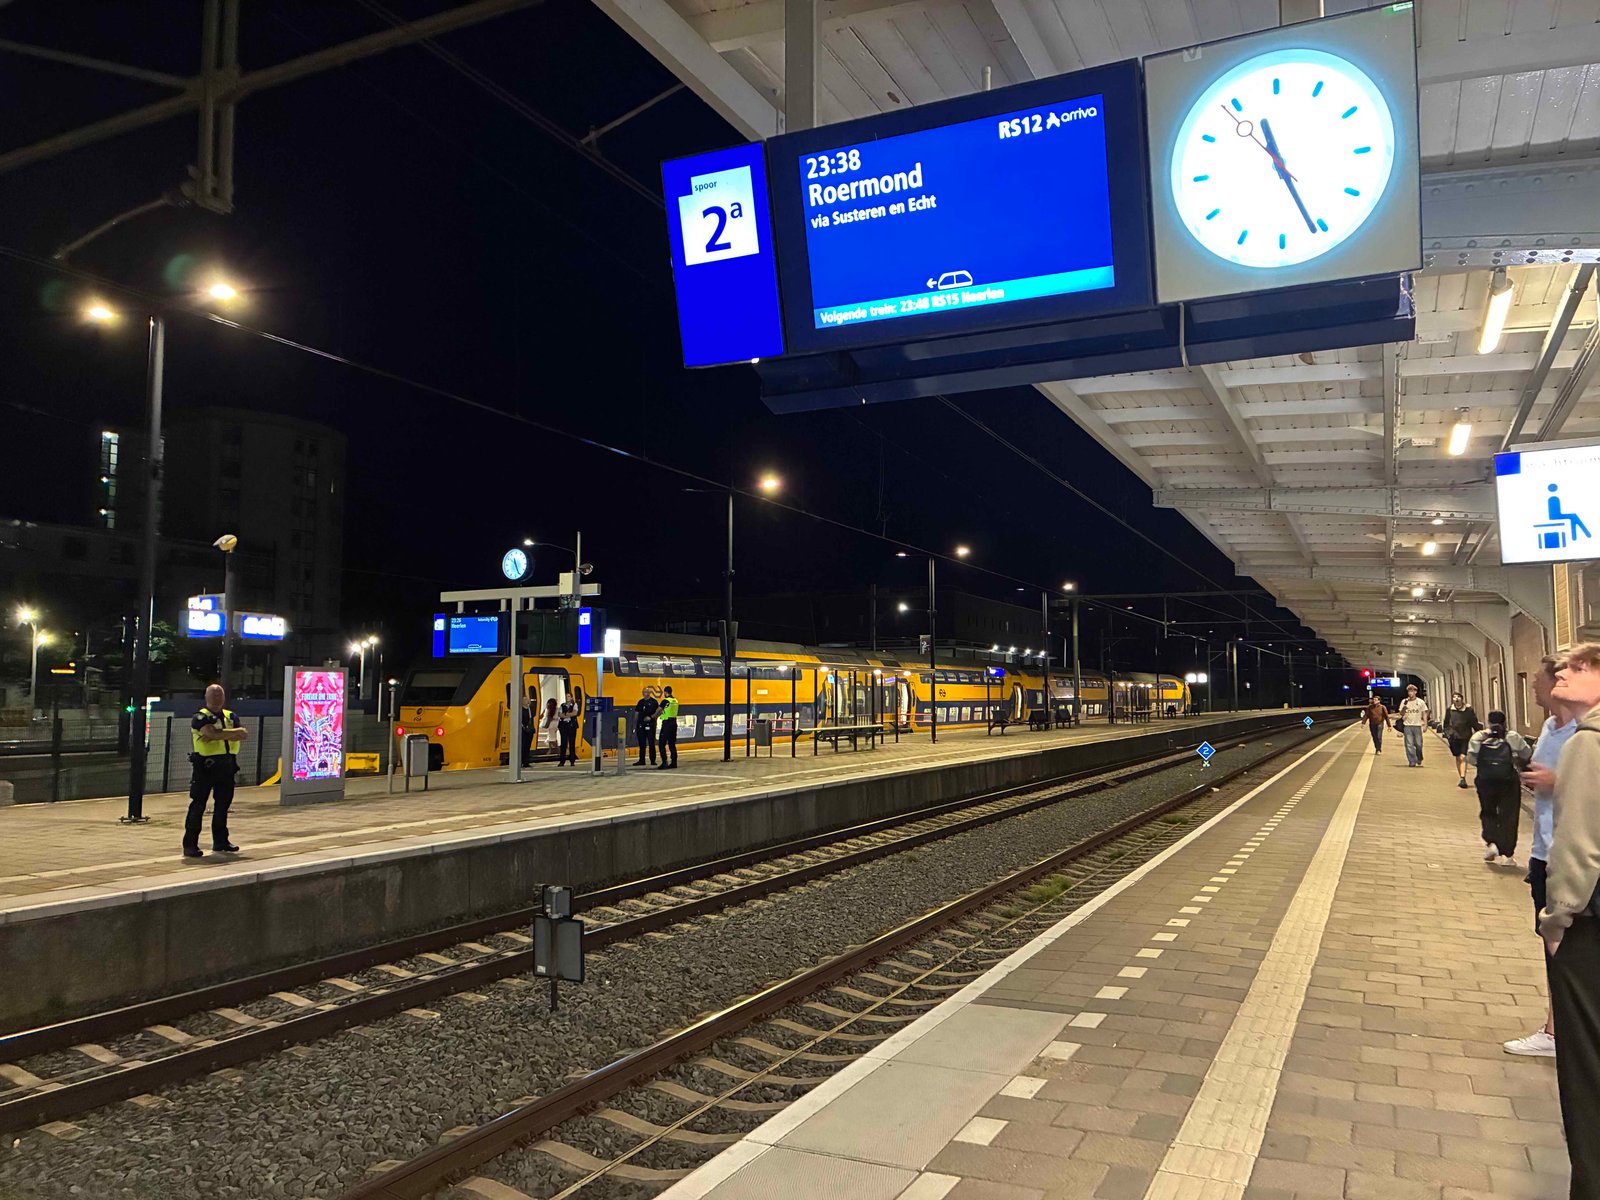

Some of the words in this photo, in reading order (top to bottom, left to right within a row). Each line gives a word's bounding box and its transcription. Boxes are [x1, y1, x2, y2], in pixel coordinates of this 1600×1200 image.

[998, 114, 1043, 140] RS12
[1061, 107, 1098, 122] arriva
[806, 149, 861, 179] 23:38
[694, 181, 717, 192] spoor
[808, 162, 923, 207] Roermond
[811, 214, 830, 229] via
[832, 205, 886, 225] Susteren
[888, 202, 905, 215] en
[907, 194, 937, 212] Echt
[820, 307, 867, 325] Volgende
[869, 304, 897, 317] trein:
[931, 293, 959, 308] RS15
[961, 287, 1005, 304] Heerlen
[1203, 746, 1209, 755] 2
